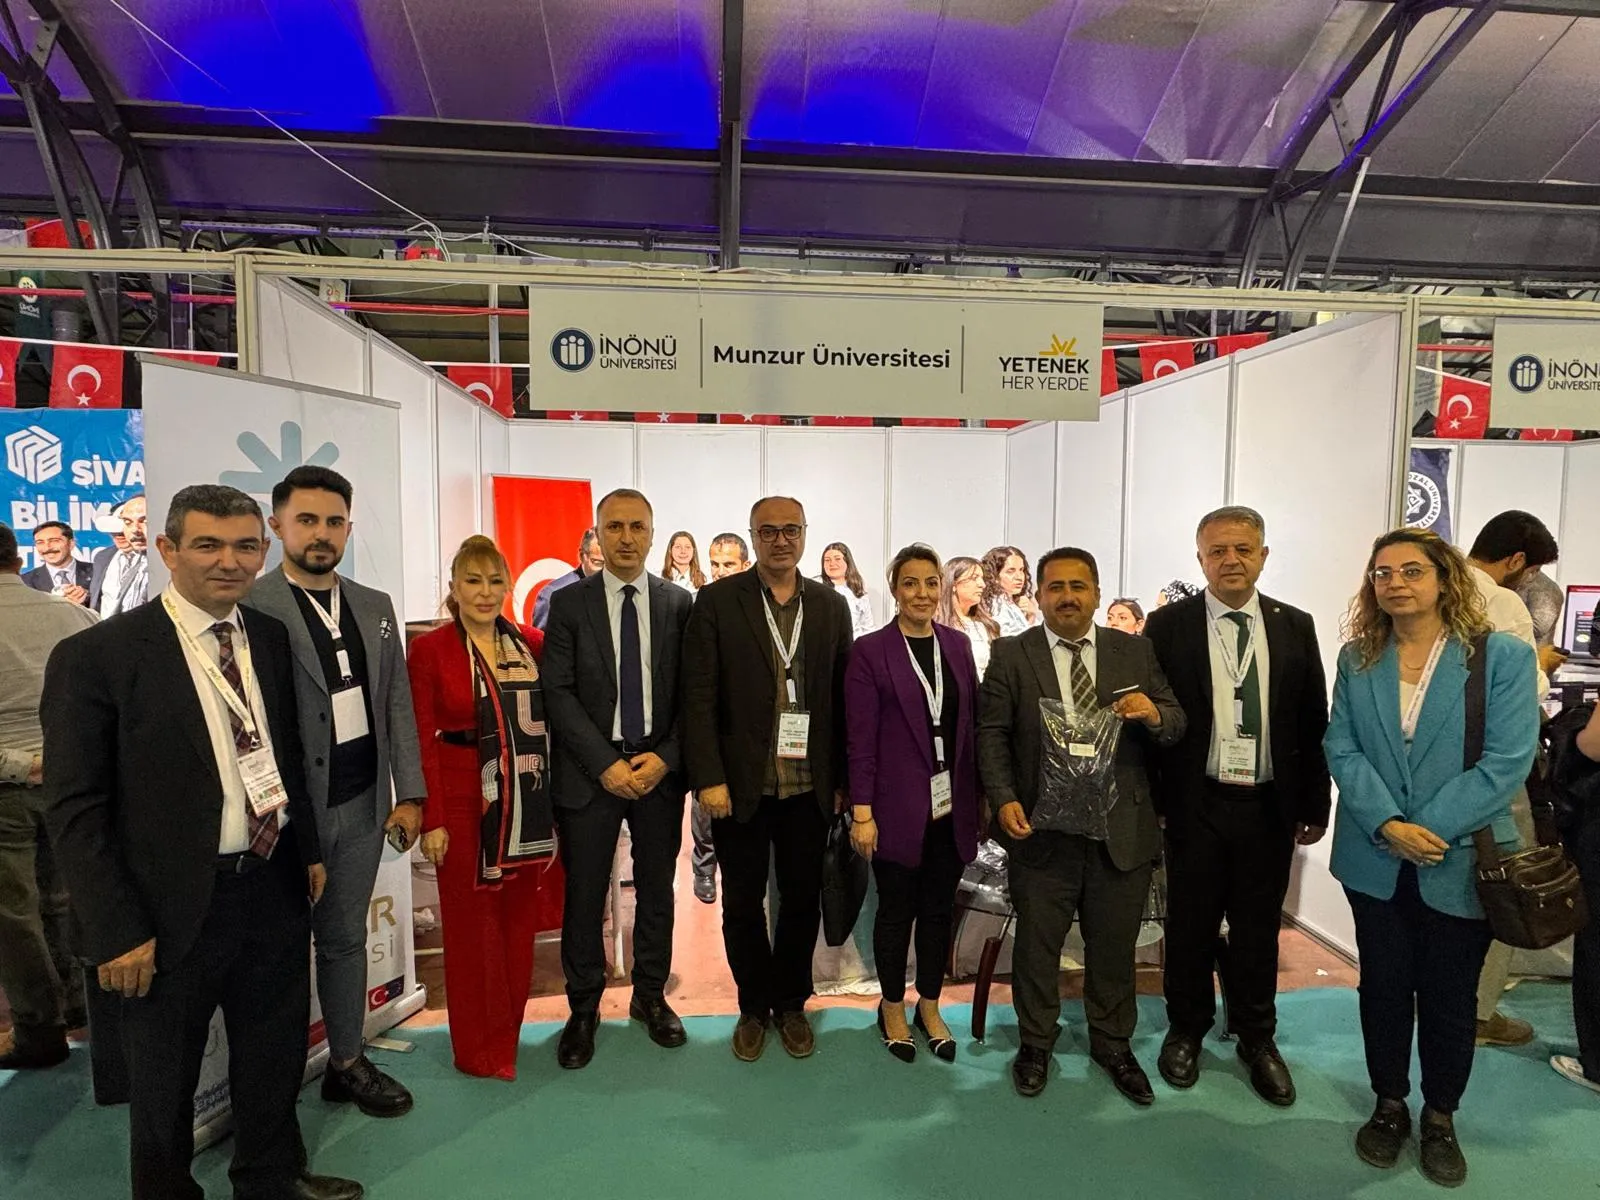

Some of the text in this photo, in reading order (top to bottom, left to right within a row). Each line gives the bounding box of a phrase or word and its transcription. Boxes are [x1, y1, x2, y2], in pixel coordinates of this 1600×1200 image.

[600, 333, 677, 356] İNÖNÜ
[600, 355, 677, 370] ÜNİVERSİTESİ
[713, 343, 950, 368] Munzur Üniversitesi
[999, 356, 1090, 374] YETENEK
[1548, 358, 1600, 378] İNÖN
[1002, 375, 1089, 391] HER YERDE
[1547, 378, 1600, 391] ÜNİVERSİTE
[71, 454, 146, 487] SİVA
